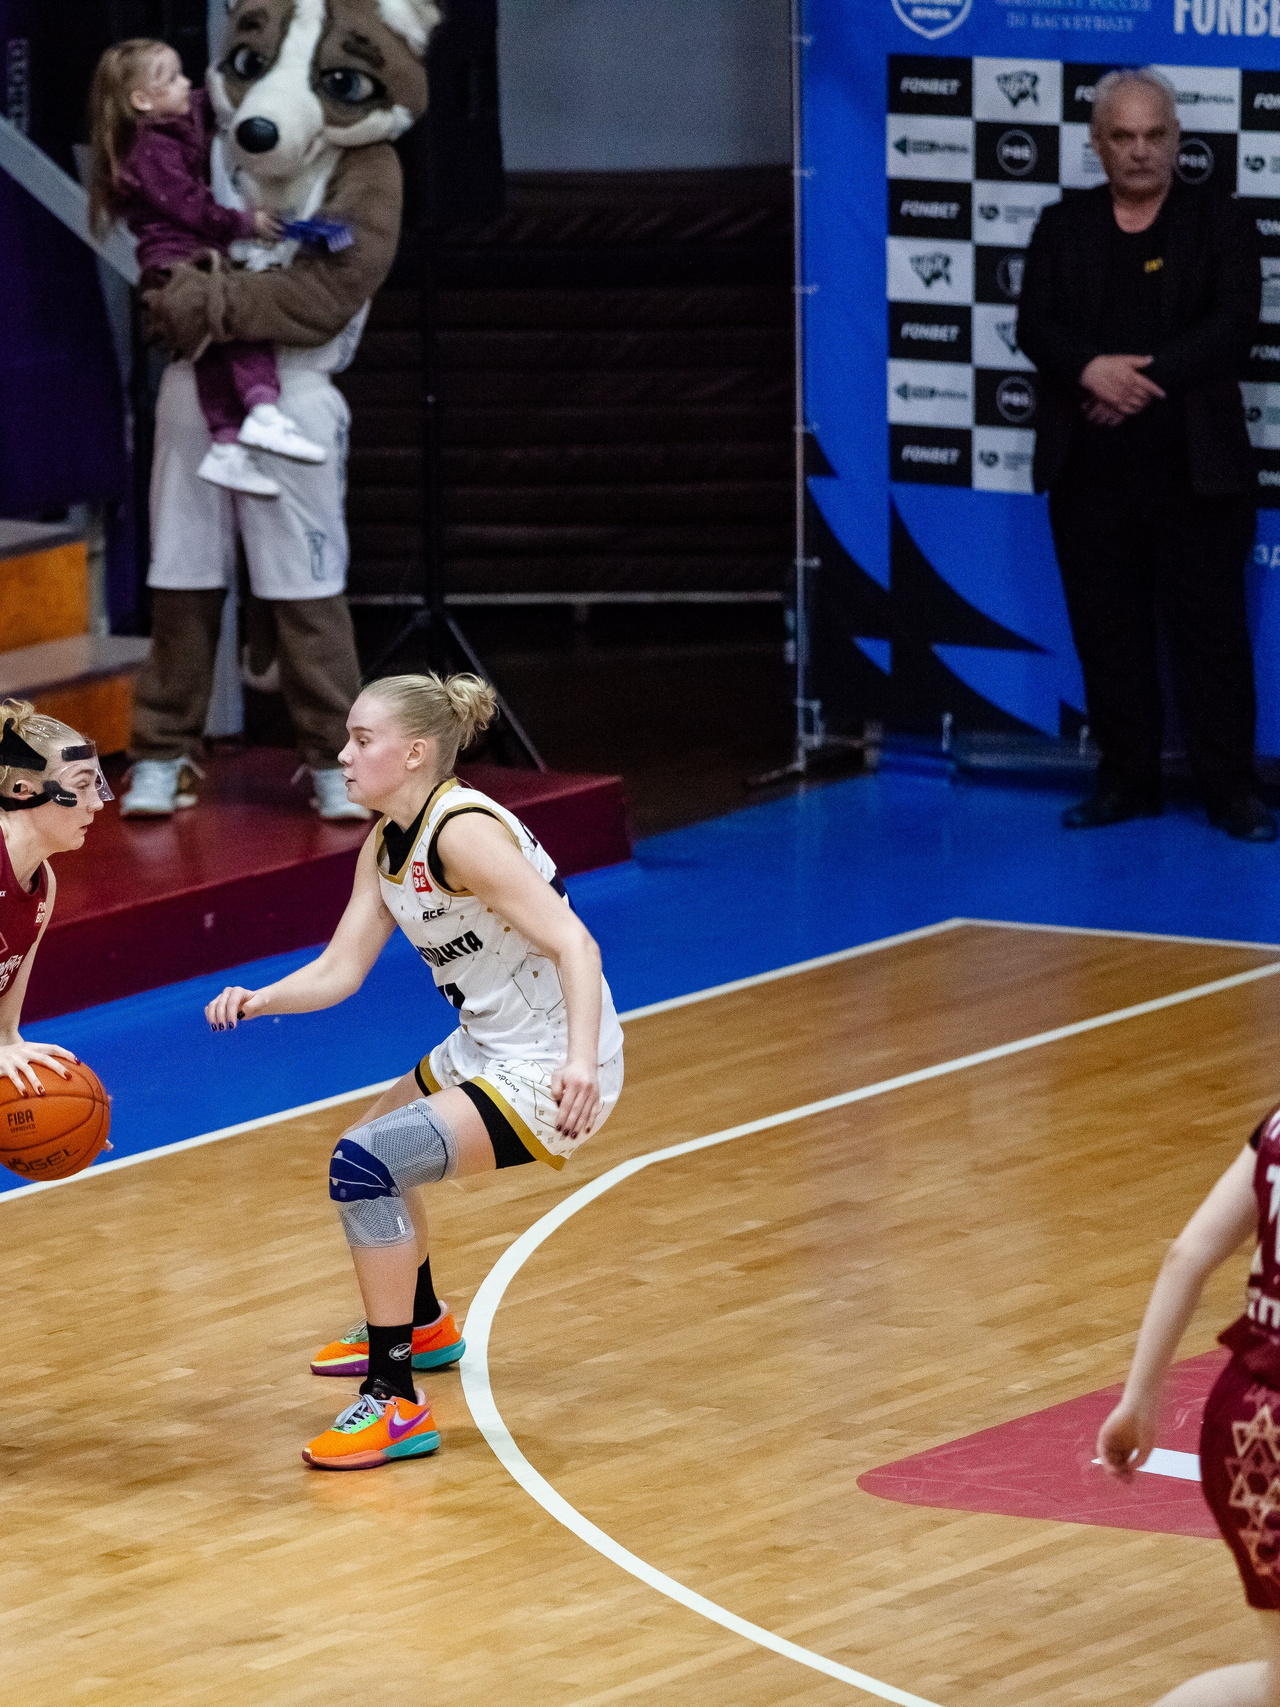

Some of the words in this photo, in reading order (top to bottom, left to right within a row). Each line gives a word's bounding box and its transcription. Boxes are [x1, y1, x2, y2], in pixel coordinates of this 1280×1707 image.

[900, 76, 961, 96] FONBET
[900, 200, 961, 220] FONBET
[900, 322, 961, 343] FONBET
[901, 444, 961, 465] FONBET
[7, 1108, 35, 1127] FIBA
